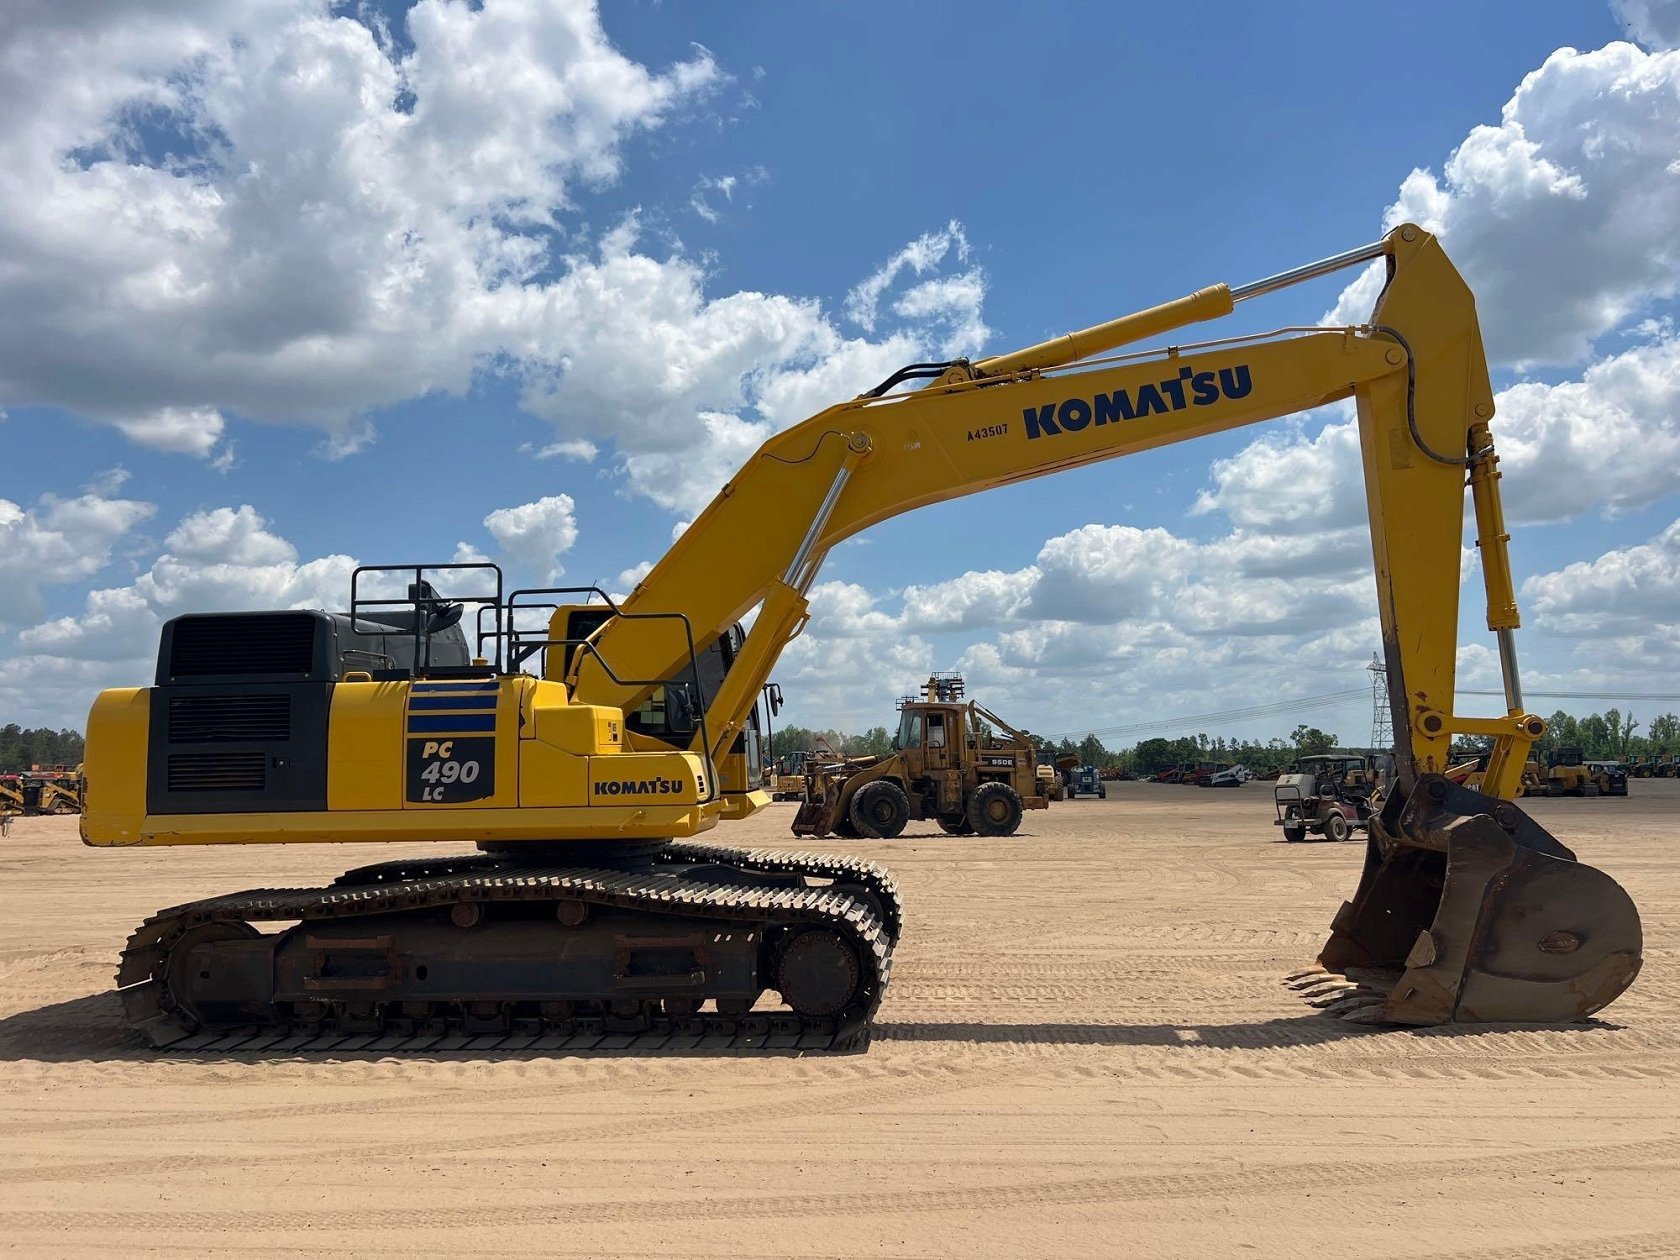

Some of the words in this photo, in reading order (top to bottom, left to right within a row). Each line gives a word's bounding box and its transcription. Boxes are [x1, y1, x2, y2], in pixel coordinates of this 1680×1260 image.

[1022, 364, 1252, 440] KOMATSU
[967, 423, 1008, 441] A43507
[422, 741, 453, 759] PC
[421, 760, 480, 784] 490
[422, 786, 445, 801] LC
[594, 776, 683, 796] KOMATSU
